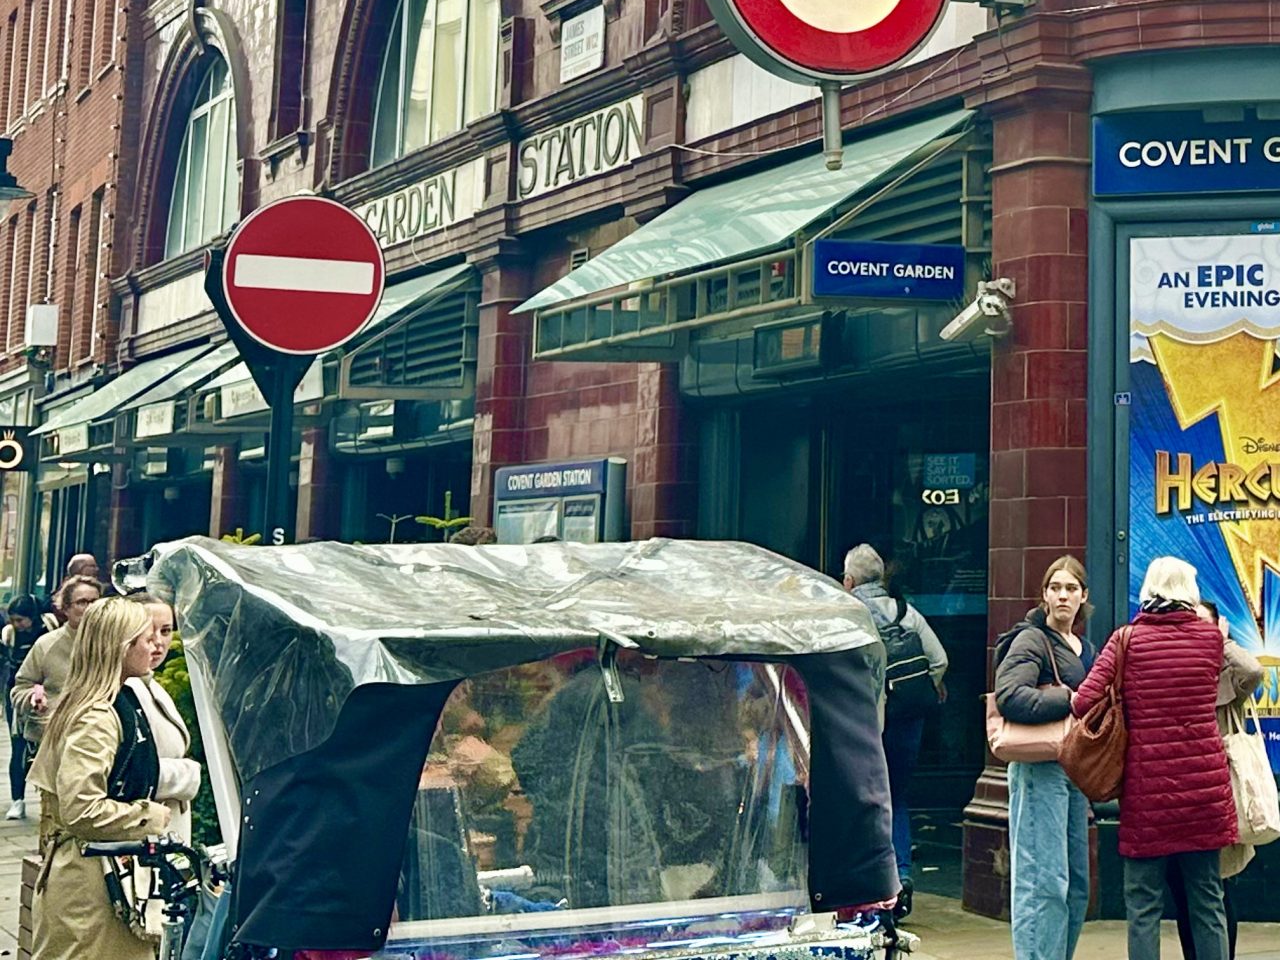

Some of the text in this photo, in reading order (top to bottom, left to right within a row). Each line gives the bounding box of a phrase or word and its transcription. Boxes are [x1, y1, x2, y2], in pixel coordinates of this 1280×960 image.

[1118, 137, 1253, 168] COVENT
[827, 260, 954, 280] COVENT GARDEN
[1158, 263, 1264, 289] AN EPIC
[1184, 290, 1280, 309] EVENING
[927, 456, 945, 466] SEE
[507, 468, 592, 491] COVENT GARDEN STATION
[926, 466, 945, 476] SAY
[1186, 514, 1205, 525] THE
[1207, 510, 1275, 523] ELECTRIFYING
